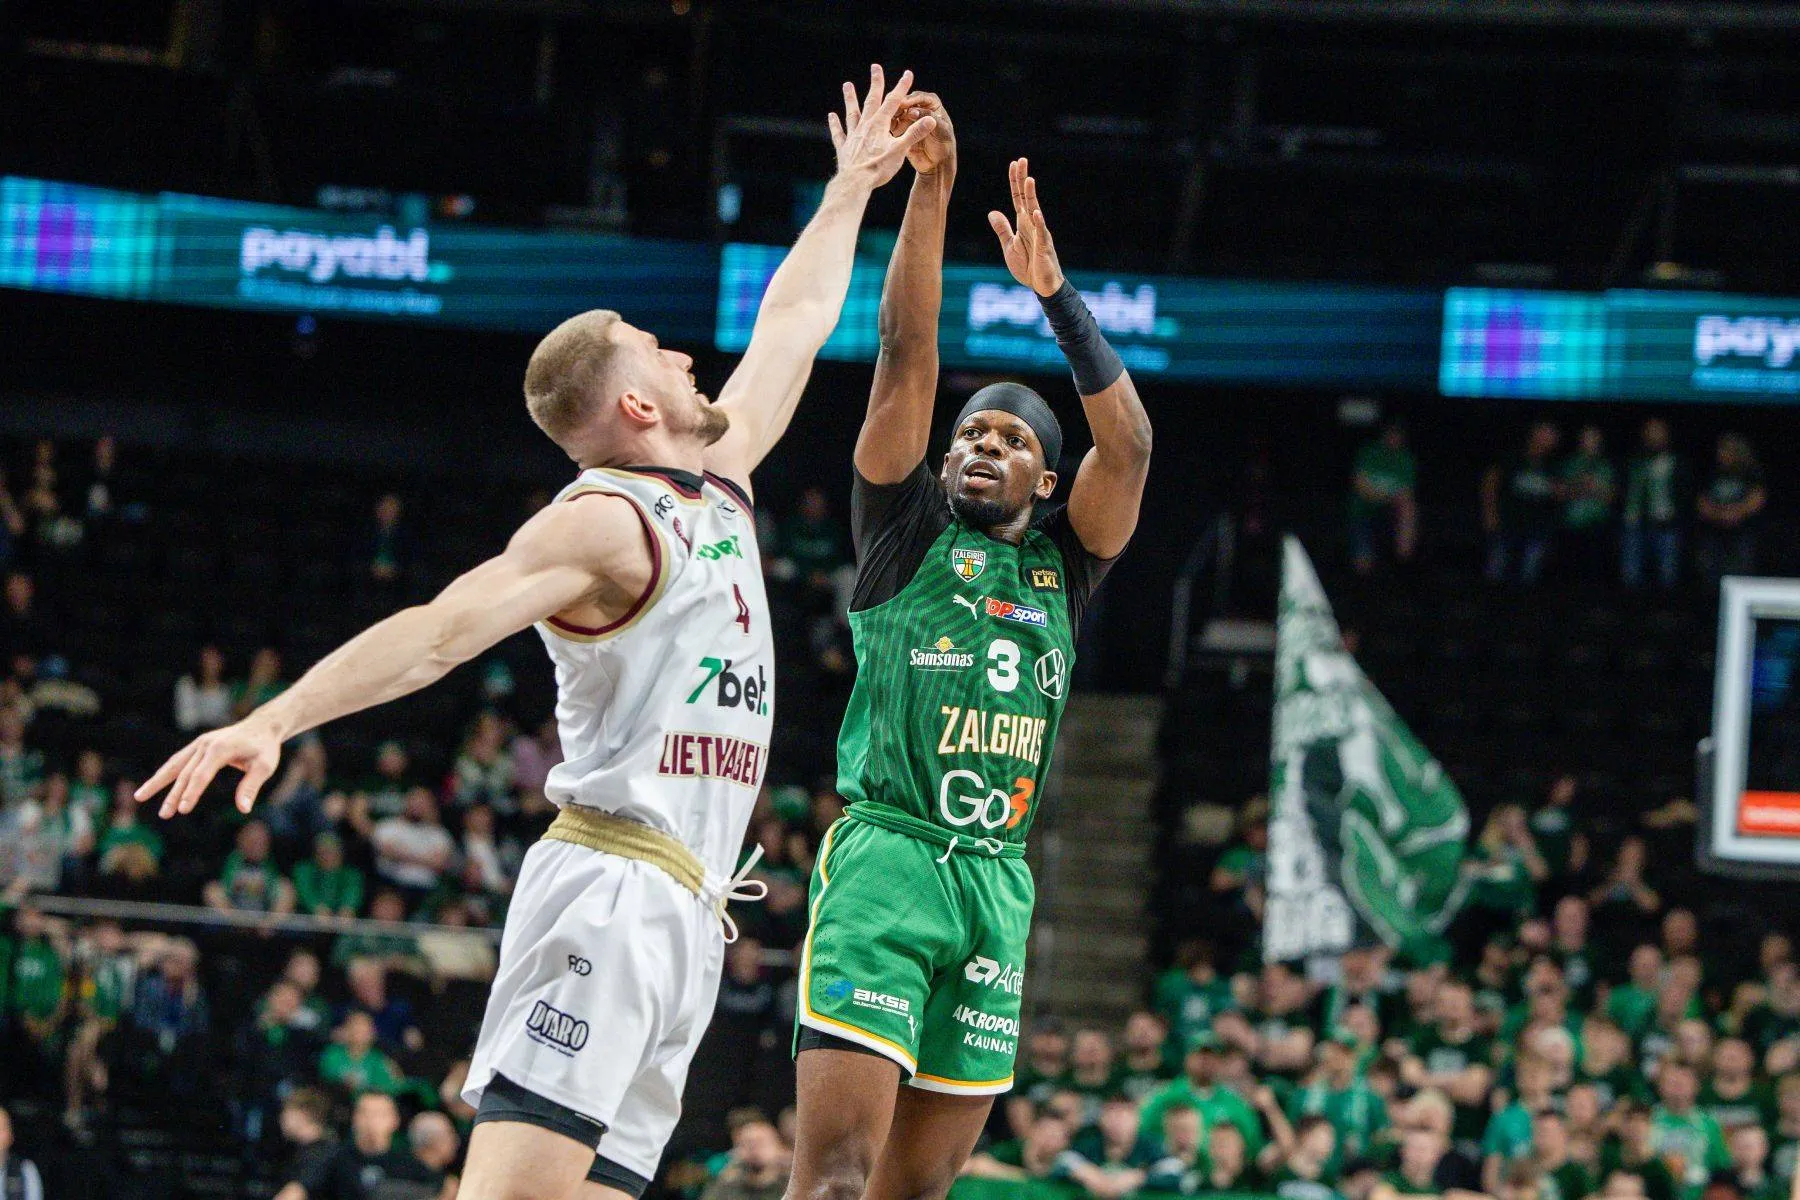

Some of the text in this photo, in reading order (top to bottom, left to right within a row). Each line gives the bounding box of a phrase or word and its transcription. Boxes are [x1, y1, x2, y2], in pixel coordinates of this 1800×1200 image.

[733, 583, 750, 633] 4
[910, 648, 975, 667] Samsonas
[987, 639, 1021, 692] 3
[940, 769, 1036, 829] Go3
[963, 1031, 1013, 1055] KAUNAS
